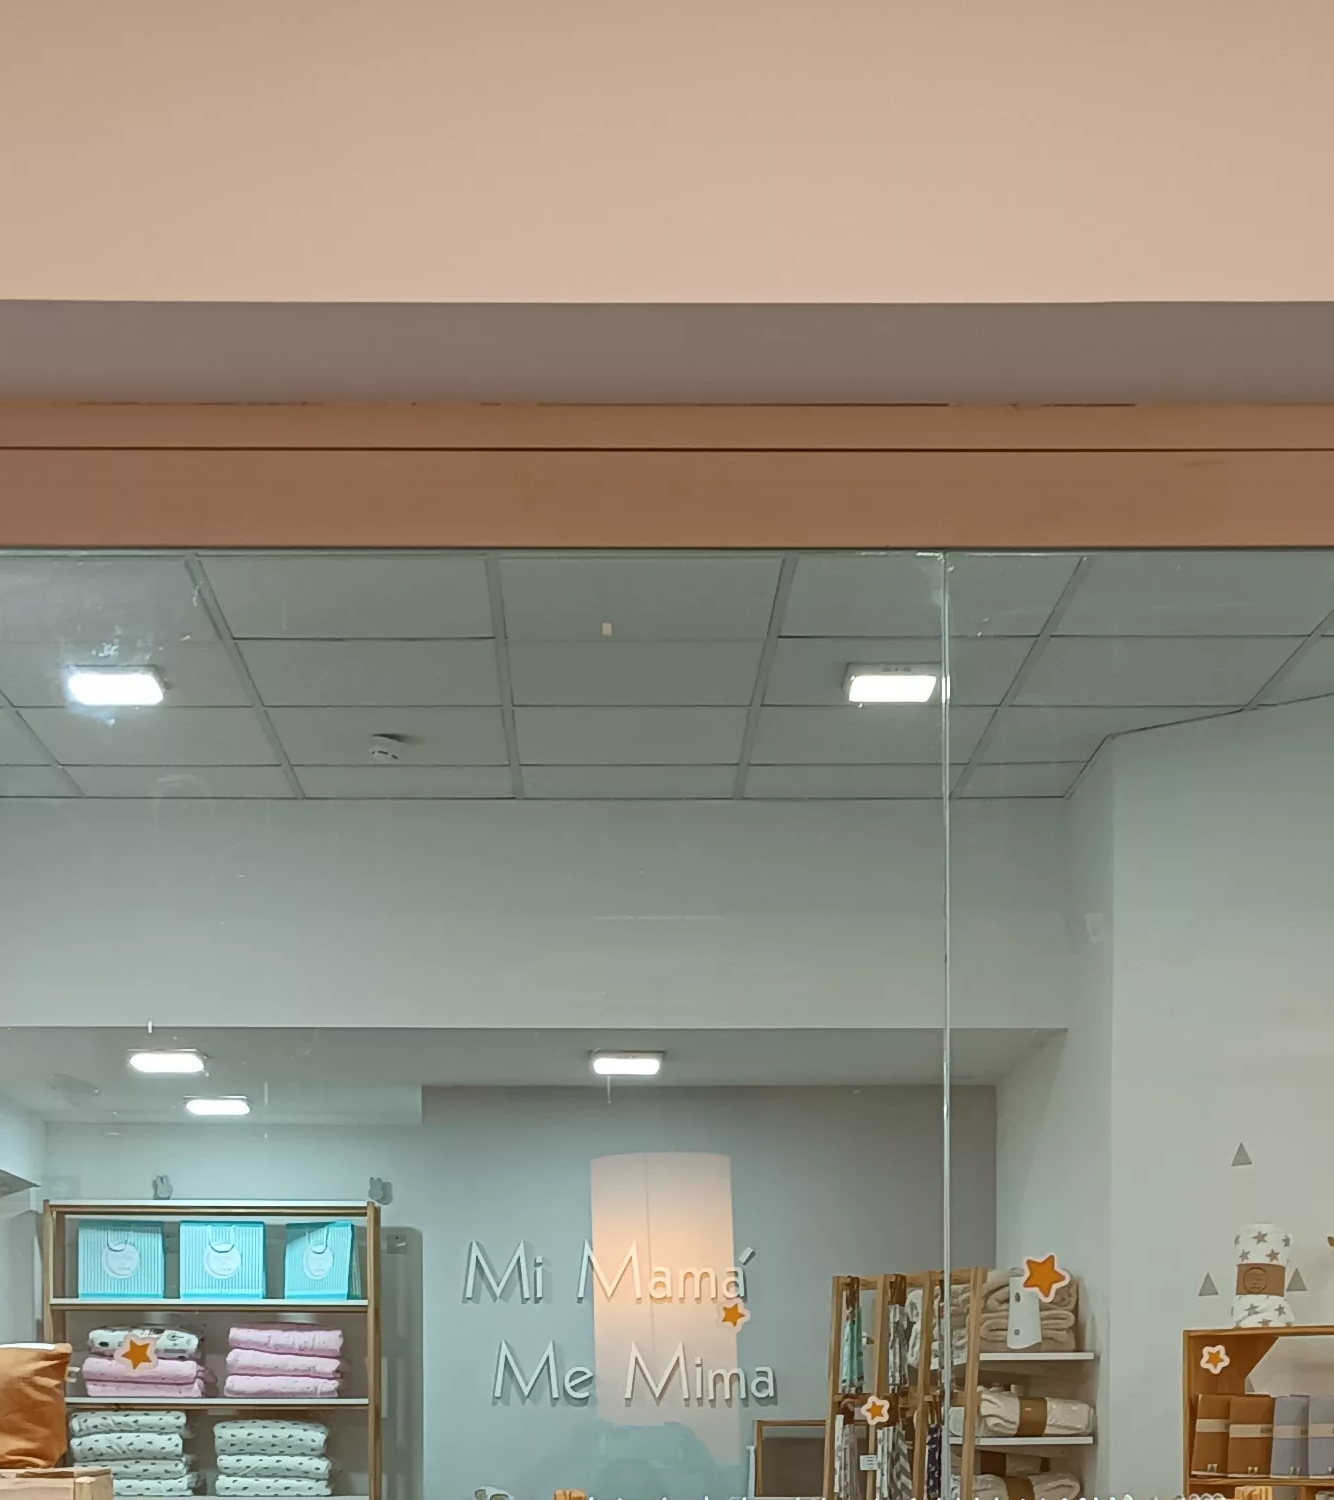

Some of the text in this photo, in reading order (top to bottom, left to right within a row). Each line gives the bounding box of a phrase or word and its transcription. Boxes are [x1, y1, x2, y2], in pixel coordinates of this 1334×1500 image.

[464, 1240, 756, 1301] Mi Mamá
[494, 1340, 776, 1401] Me Mima
